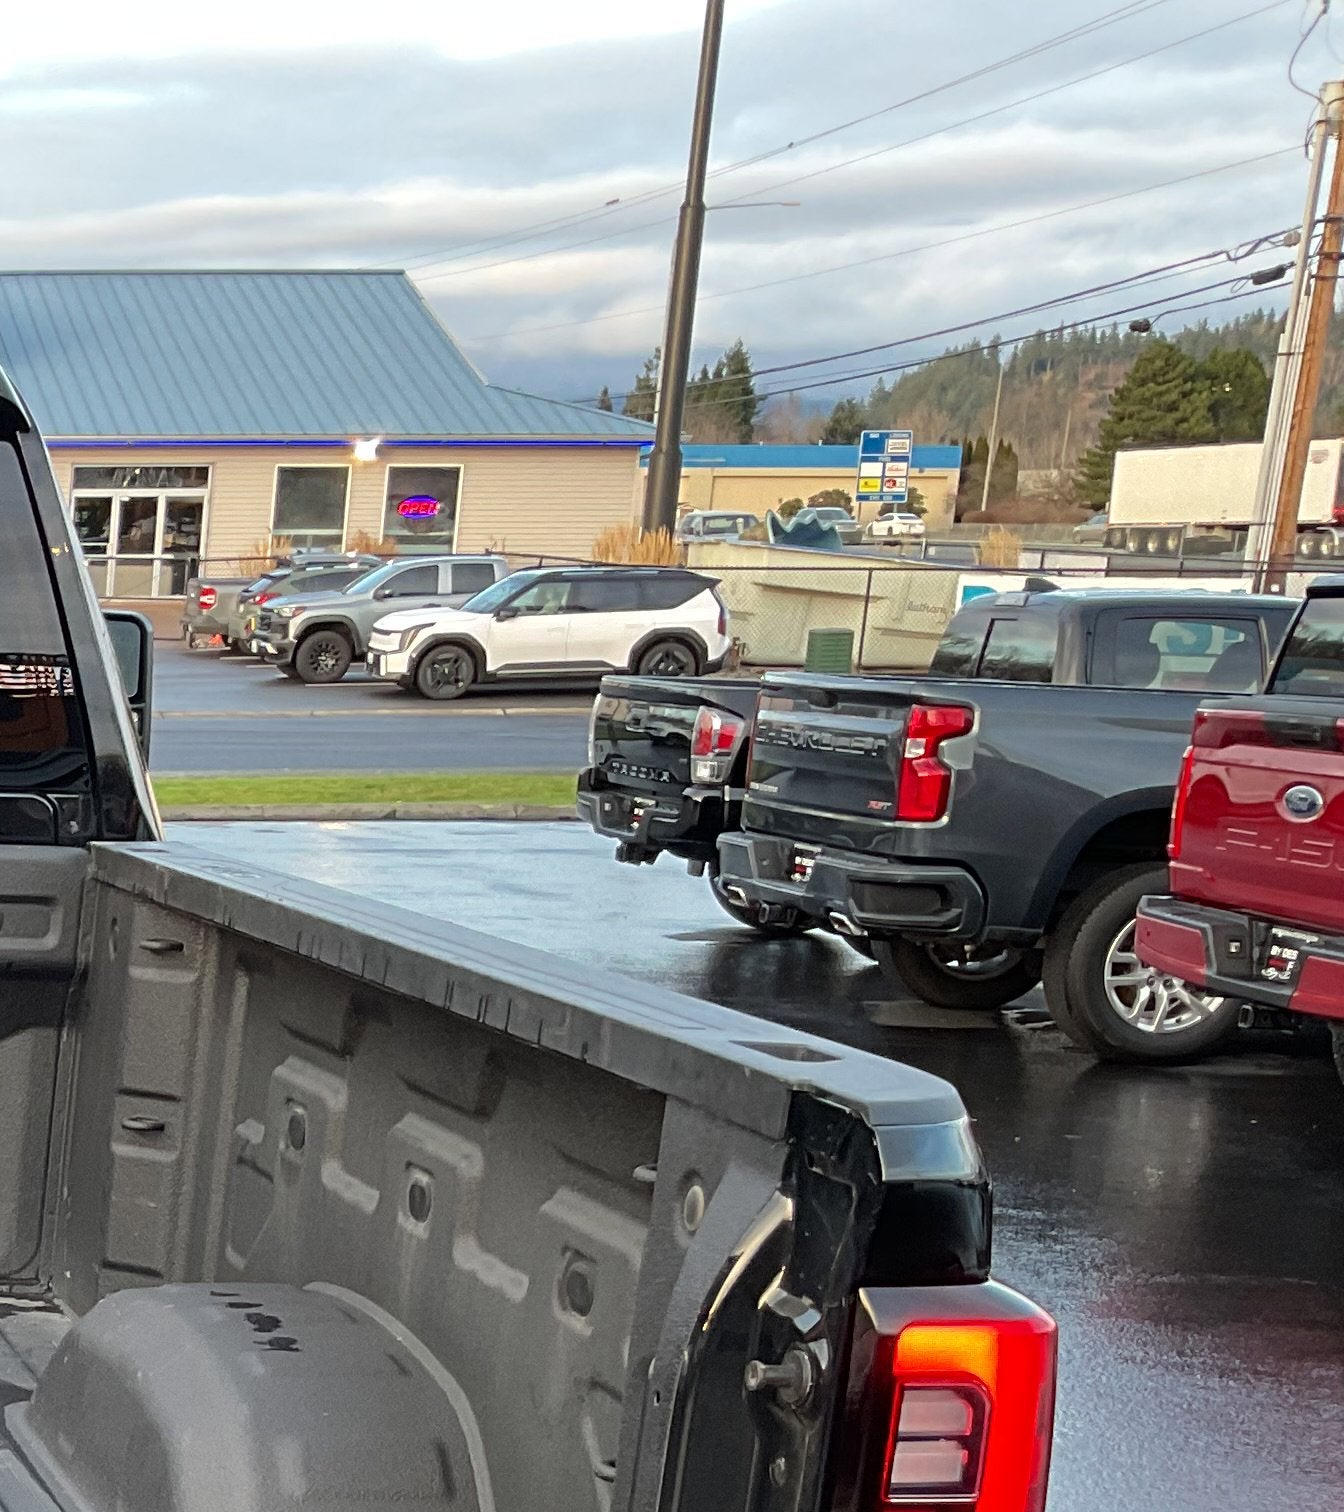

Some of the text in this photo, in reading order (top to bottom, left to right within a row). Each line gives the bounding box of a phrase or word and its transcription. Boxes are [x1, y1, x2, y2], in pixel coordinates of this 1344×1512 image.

[398, 502, 440, 515] OPEN
[612, 762, 671, 783] TACOMA
[1216, 827, 1344, 872] F-15
